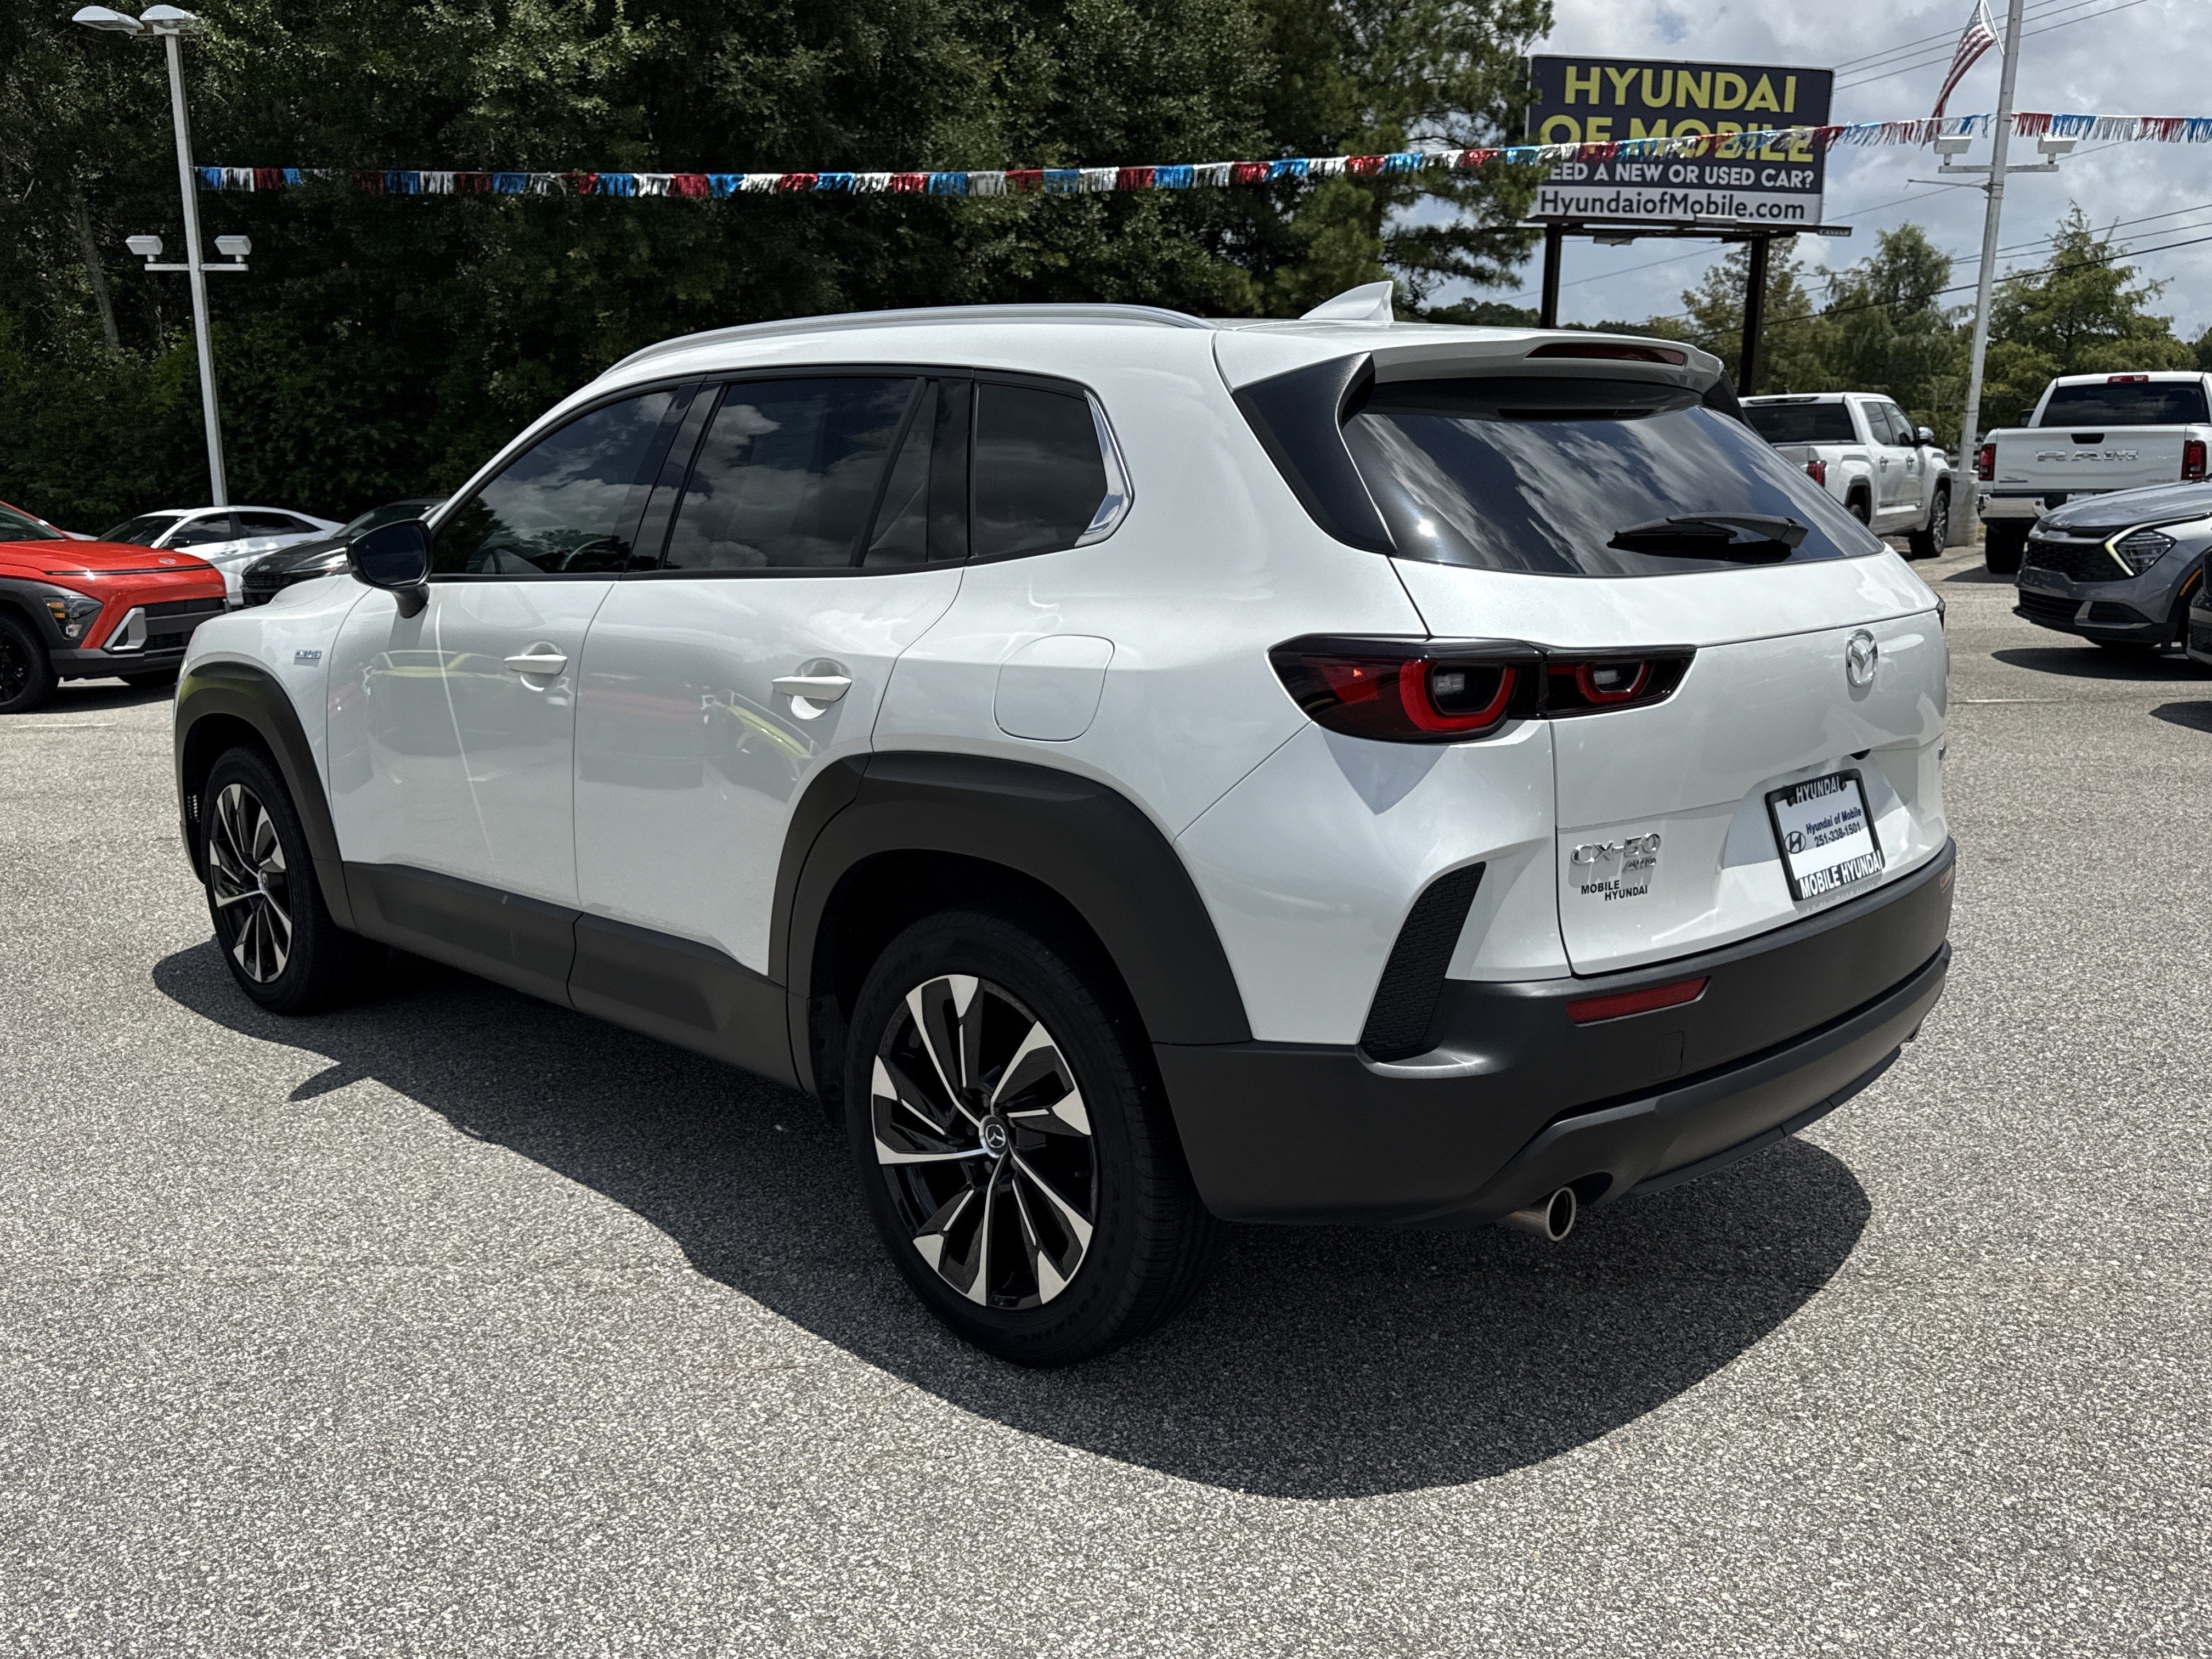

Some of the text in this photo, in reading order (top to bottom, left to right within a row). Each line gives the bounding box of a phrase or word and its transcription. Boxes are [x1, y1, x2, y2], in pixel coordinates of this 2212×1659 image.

[1564, 65, 1797, 114] HYUNDAI
[1540, 114, 1814, 163] OF MOBILE
[1543, 162, 1814, 189] EED A NEW OR USED CAR?
[1540, 190, 1804, 219] HyundaiofMobile.com
[2035, 449, 2138, 462] RAM
[1796, 775, 1840, 804] HYUNDAI
[1805, 806, 1861, 835] Hyundai of Mobile
[1814, 821, 1861, 848] 251-338-1501
[1571, 832, 1661, 866] CX-50
[1581, 879, 1620, 895] MOBILE
[1799, 850, 1883, 899] MOBILE HYUNDAI
[1604, 884, 1648, 901] HYUNDAI
